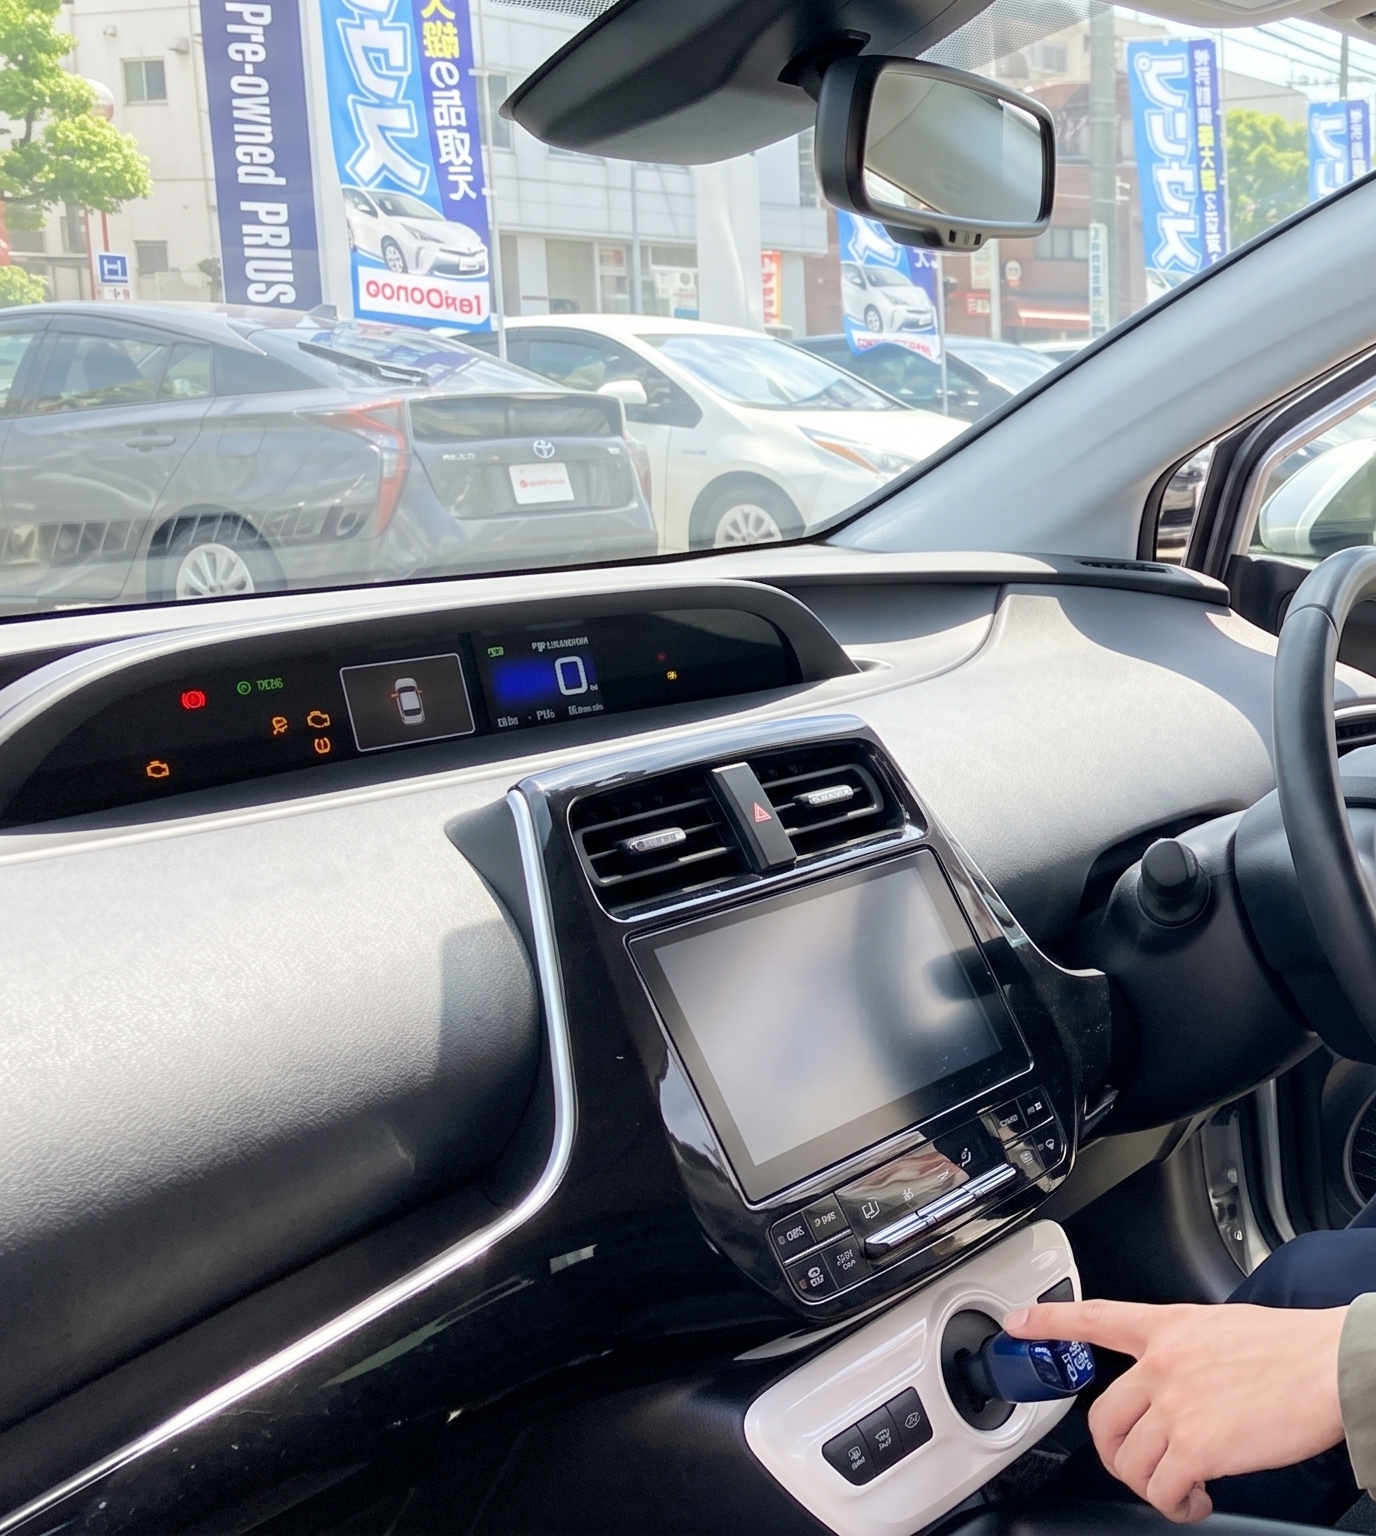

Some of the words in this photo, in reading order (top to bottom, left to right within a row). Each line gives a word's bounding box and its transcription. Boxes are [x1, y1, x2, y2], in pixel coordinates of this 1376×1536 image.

[225, 2, 287, 186] Pre-owned
[240, 201, 297, 304] PRIUS
[554, 655, 589, 697] 0
